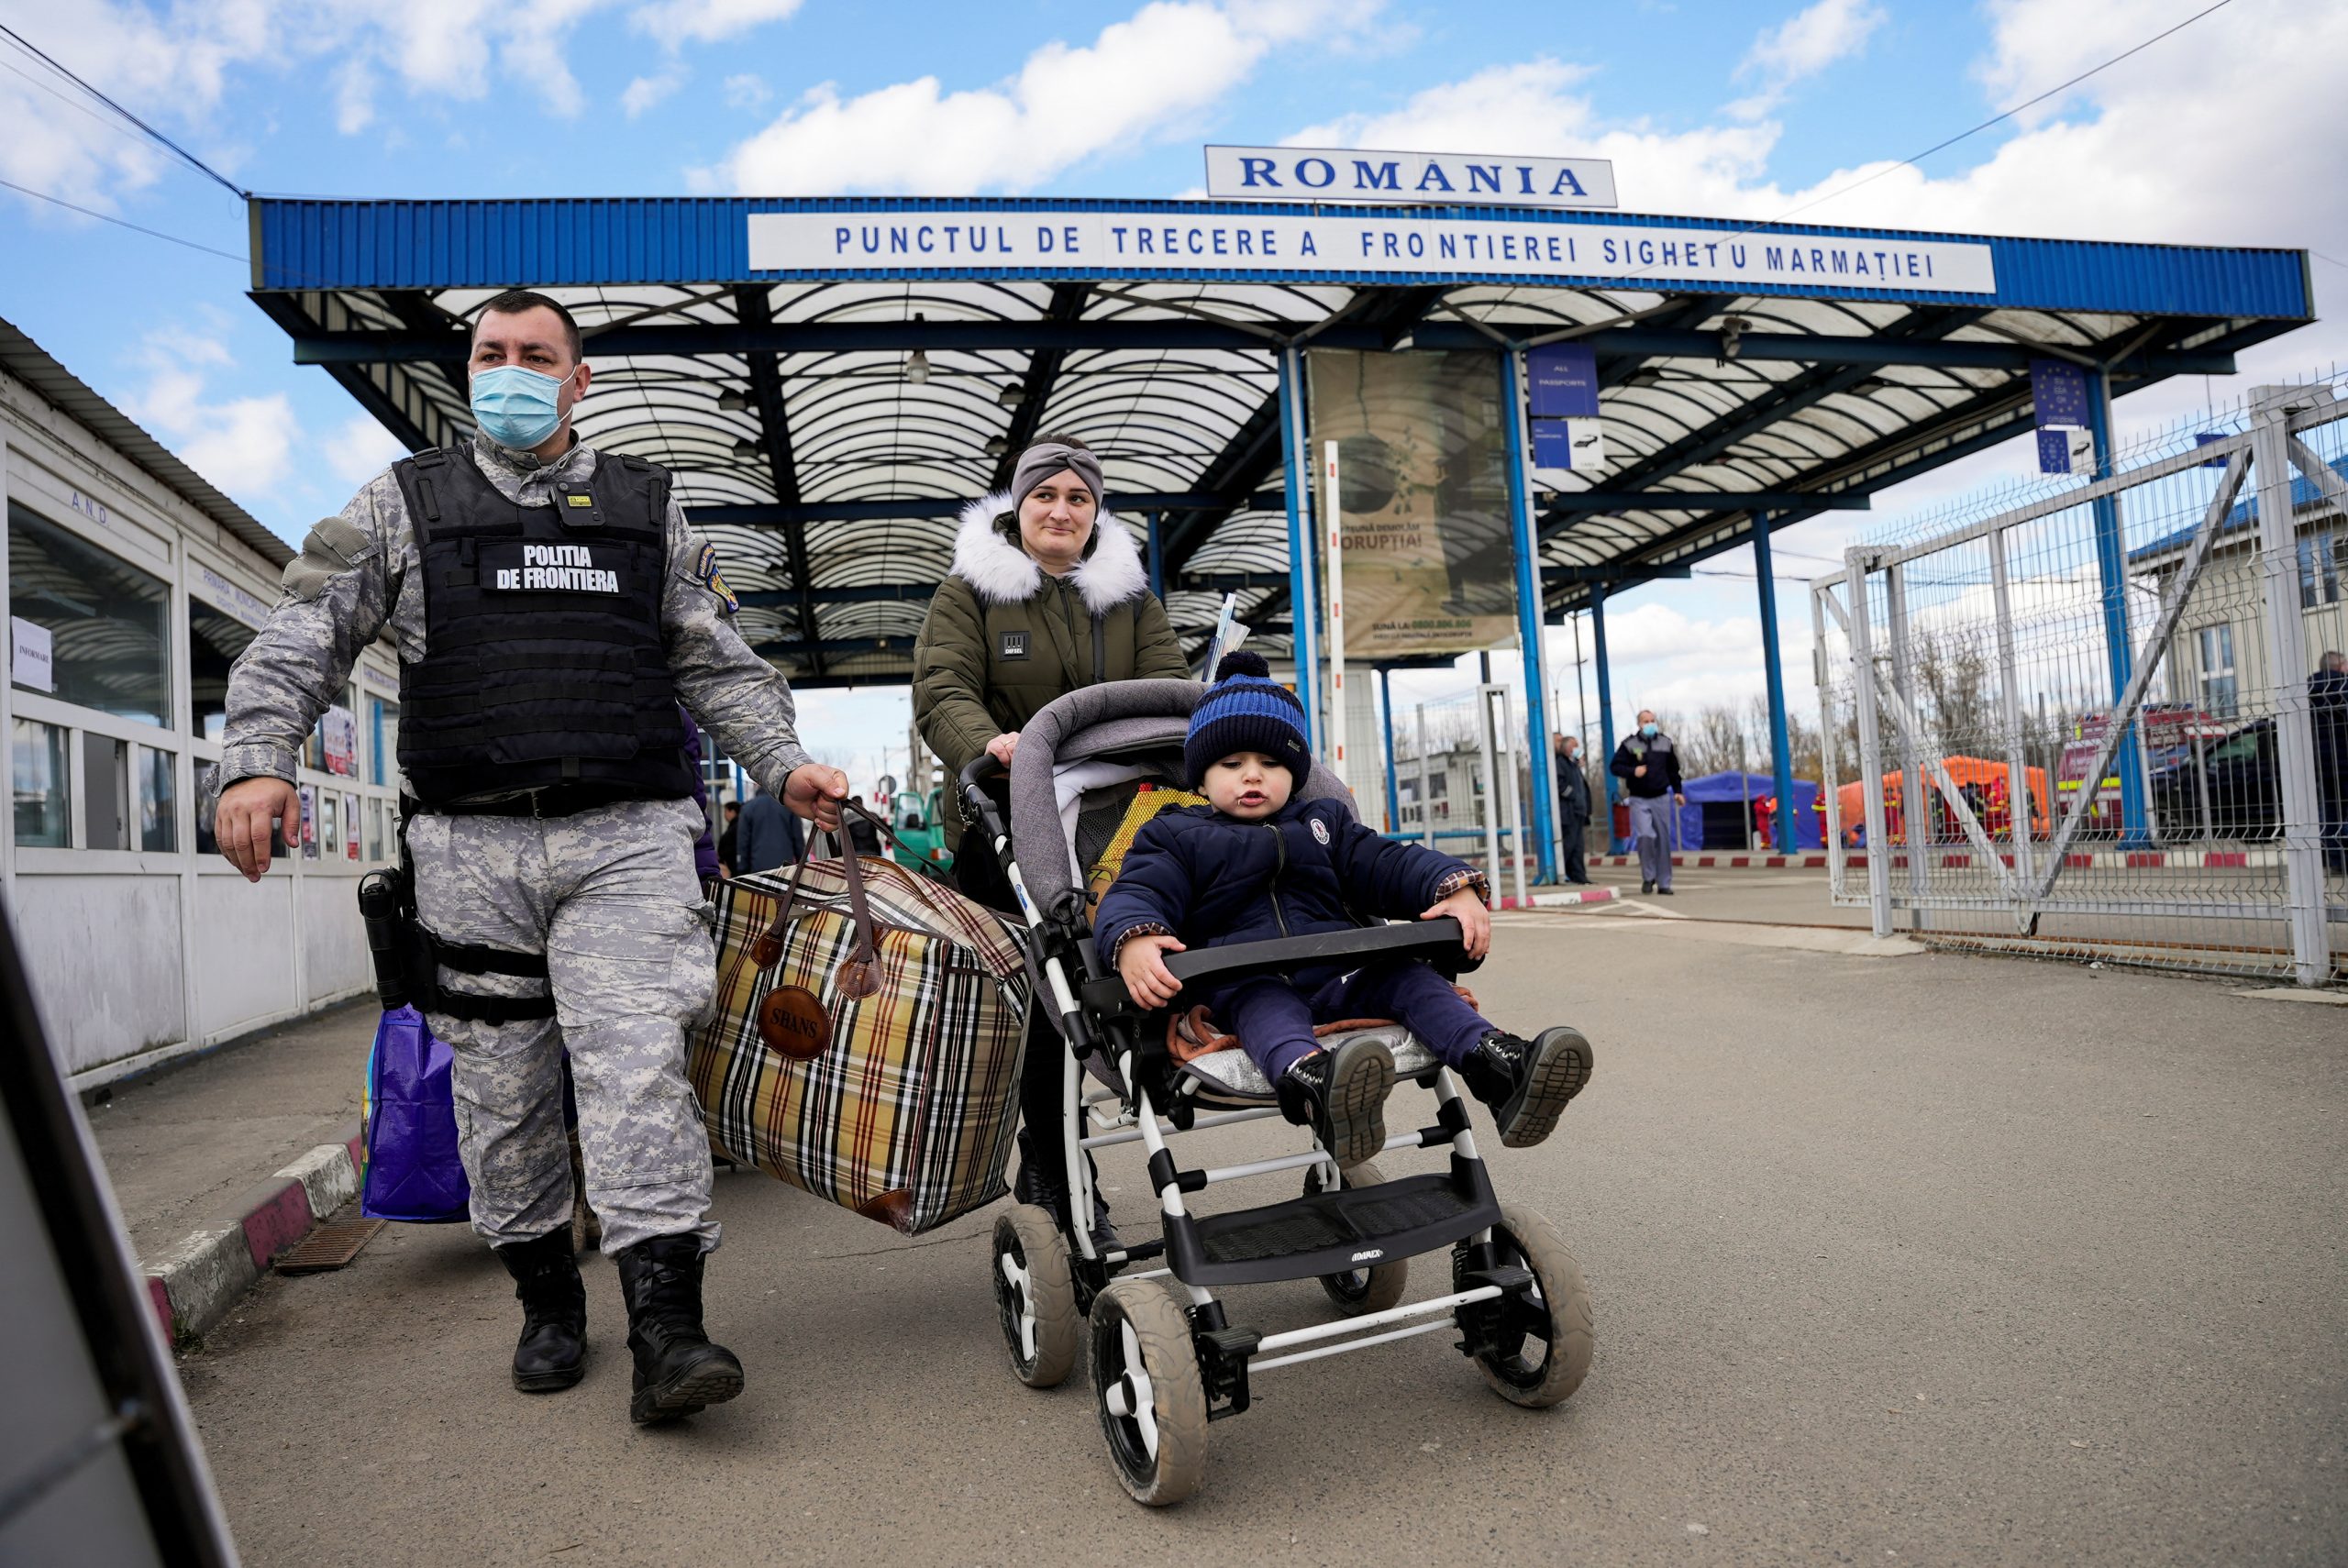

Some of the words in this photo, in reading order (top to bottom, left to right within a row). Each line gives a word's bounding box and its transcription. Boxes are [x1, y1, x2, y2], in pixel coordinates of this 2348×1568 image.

[1238, 157, 1588, 196] ROMÂNIA
[836, 226, 1013, 254] PUNCTUL
[1036, 226, 1080, 253] DE
[1111, 227, 1278, 255] TRECERE
[1300, 230, 1318, 256] A
[1361, 231, 1576, 262] FRONTIEREI
[1766, 247, 1933, 281] MARMAȚIEI
[524, 545, 592, 567] POLITIA
[1340, 534, 1423, 552] ORUPȚIA!
[496, 569, 521, 590] DE
[524, 567, 619, 592] FRONTIERA
[770, 1007, 818, 1039] SHANS
